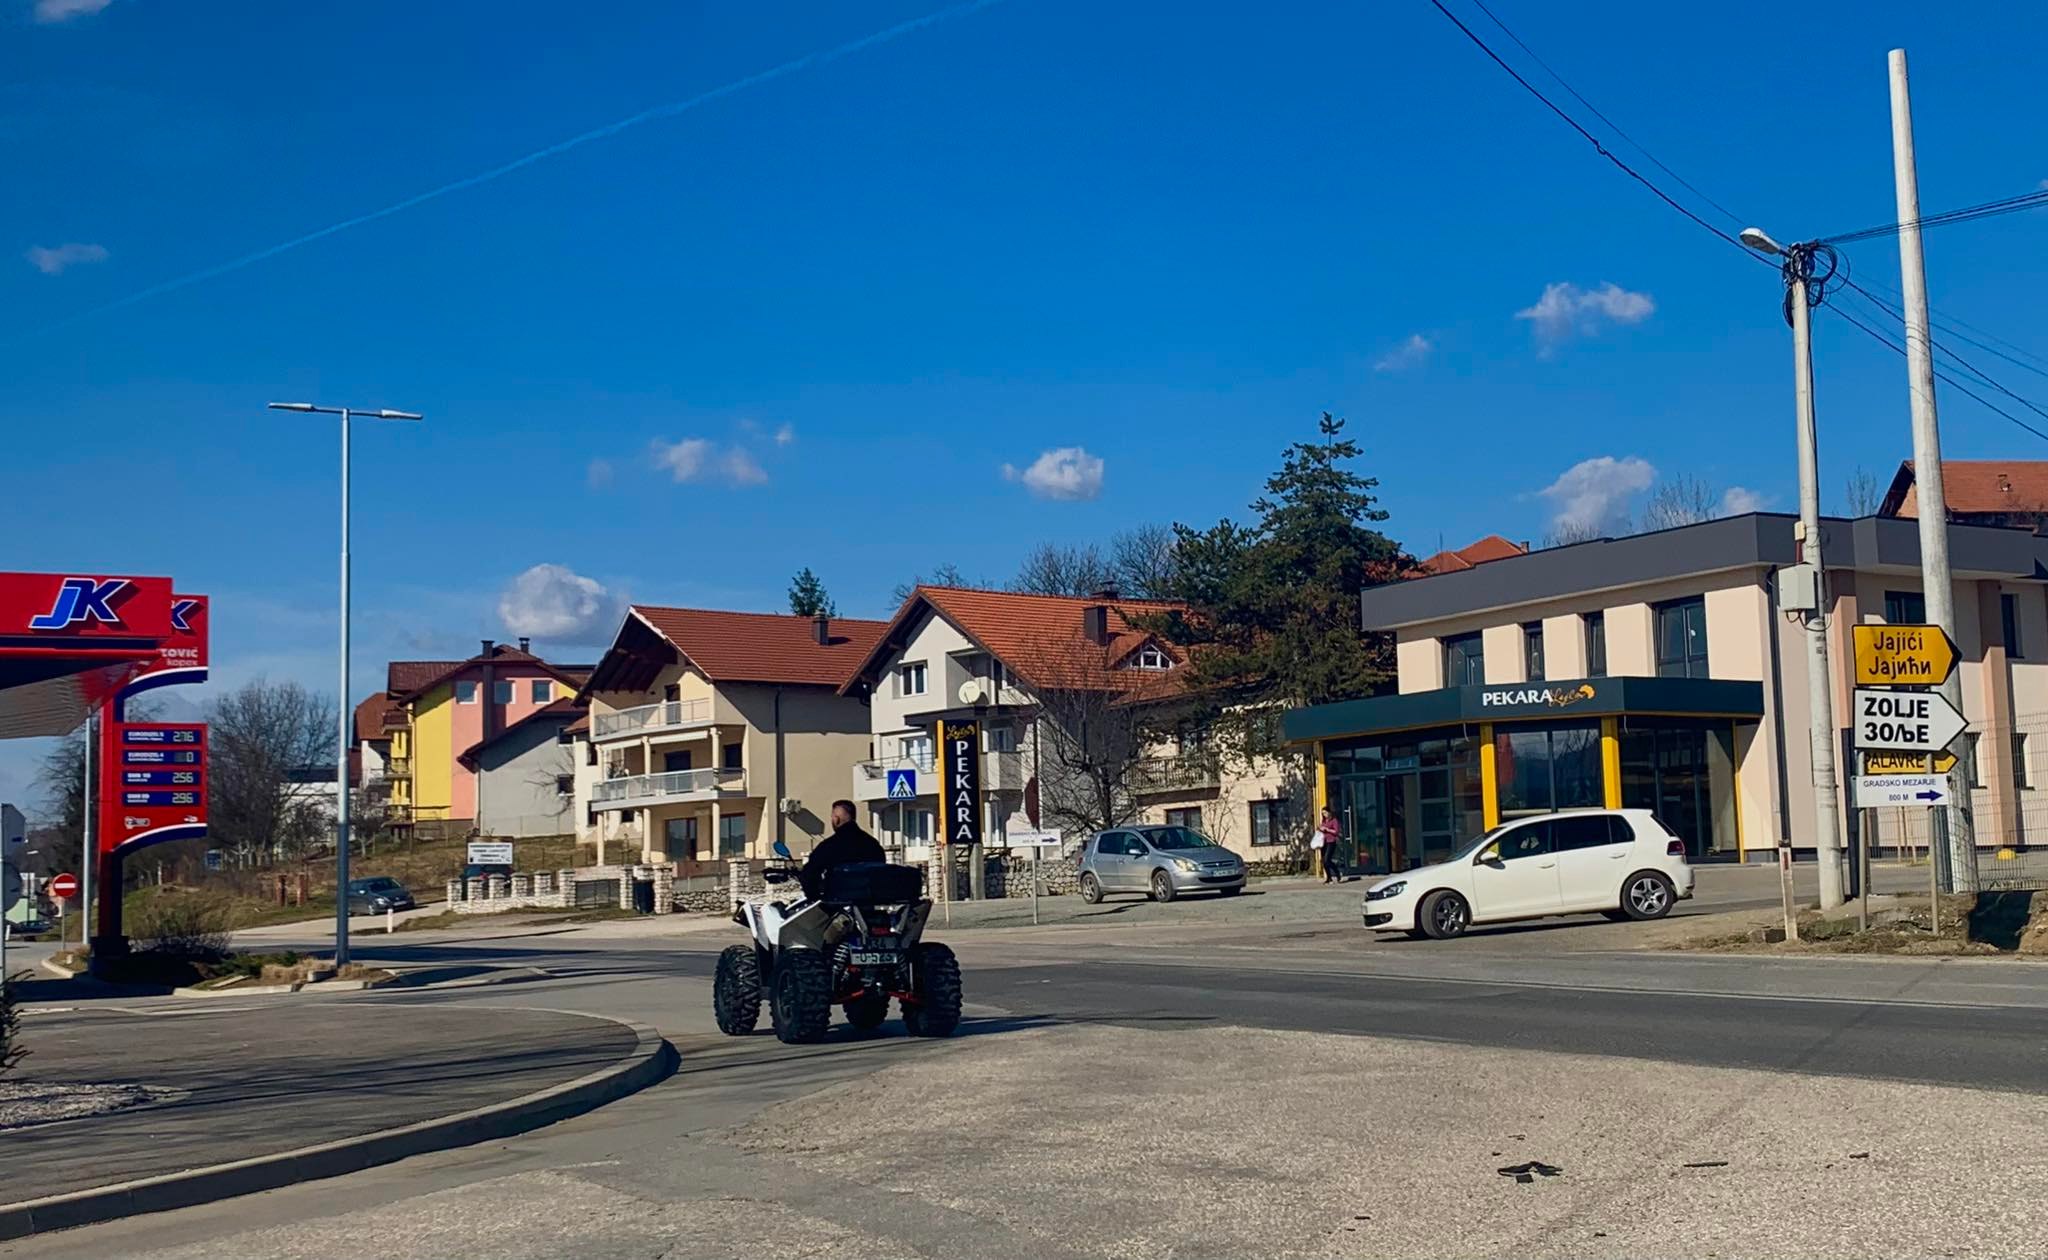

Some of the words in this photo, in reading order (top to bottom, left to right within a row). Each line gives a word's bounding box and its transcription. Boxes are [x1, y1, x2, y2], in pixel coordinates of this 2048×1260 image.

[28, 577, 132, 630] JK
[1873, 631, 1923, 655] Jajići
[1482, 689, 1554, 706] PEKARA
[1864, 697, 1929, 719] ZOLJE
[1864, 722, 1929, 743] ЗОЉЕ
[1865, 752, 1925, 768] PALAVRE
[955, 741, 972, 839] PEKARA
[1863, 779, 1901, 788] GRADSKO
[1902, 778, 1936, 786] MEZARJE
